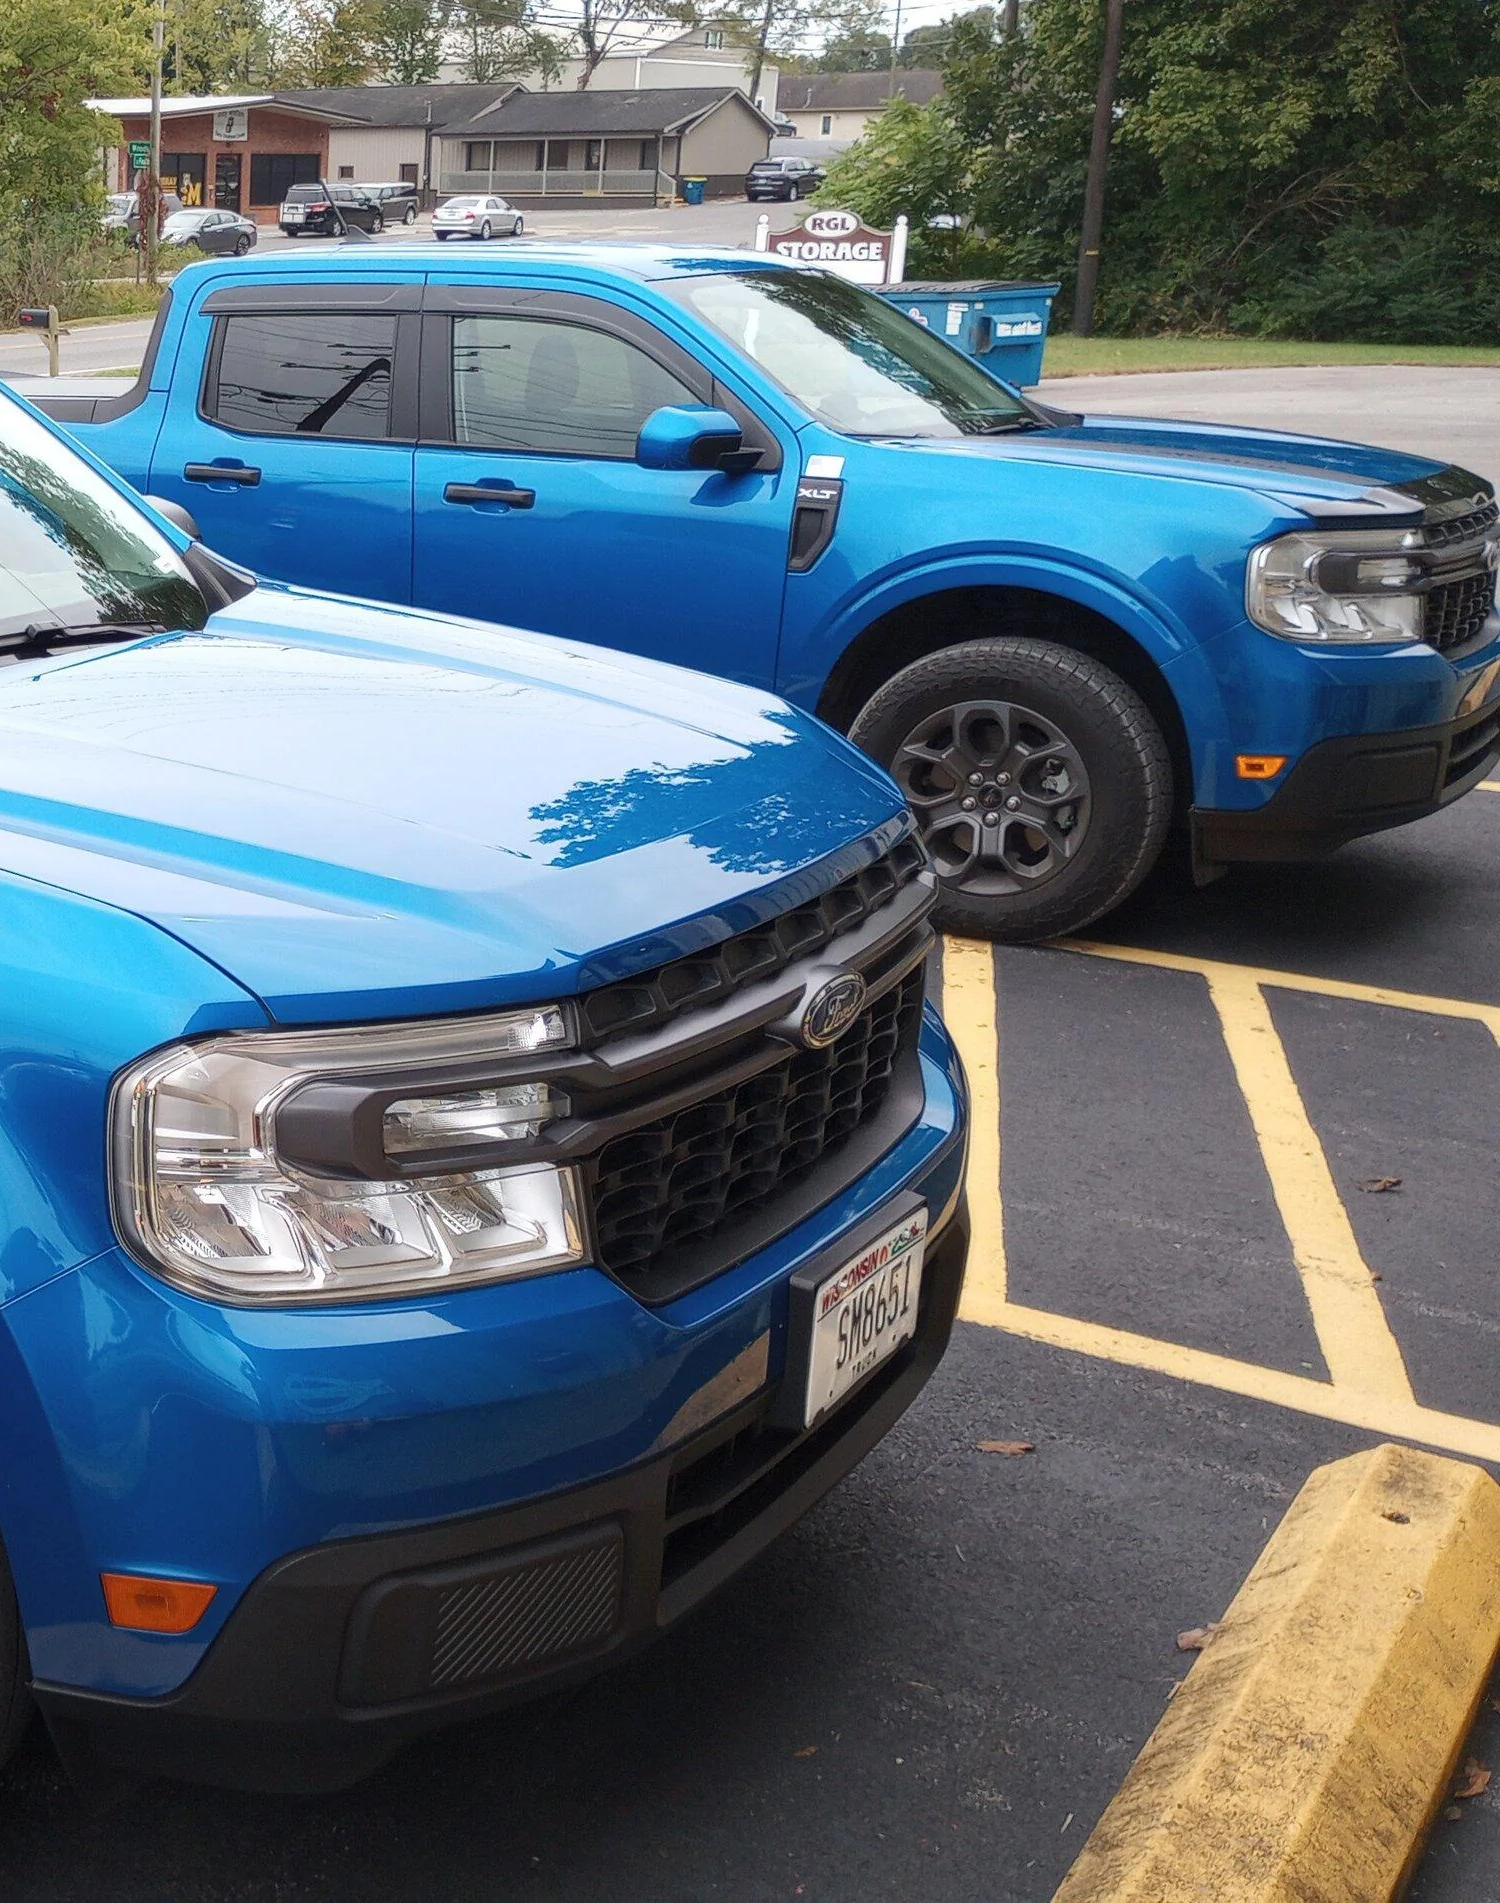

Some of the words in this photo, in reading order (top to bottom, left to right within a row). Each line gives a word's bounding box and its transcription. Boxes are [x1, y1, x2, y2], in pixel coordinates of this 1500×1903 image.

[811, 217, 850, 231] RGL
[776, 241, 883, 260] STORAGE
[797, 488, 837, 499] XLT
[817, 989, 858, 1036] Ford
[822, 1248, 879, 1315] WISCONSIN
[836, 1254, 912, 1371] SM8651
